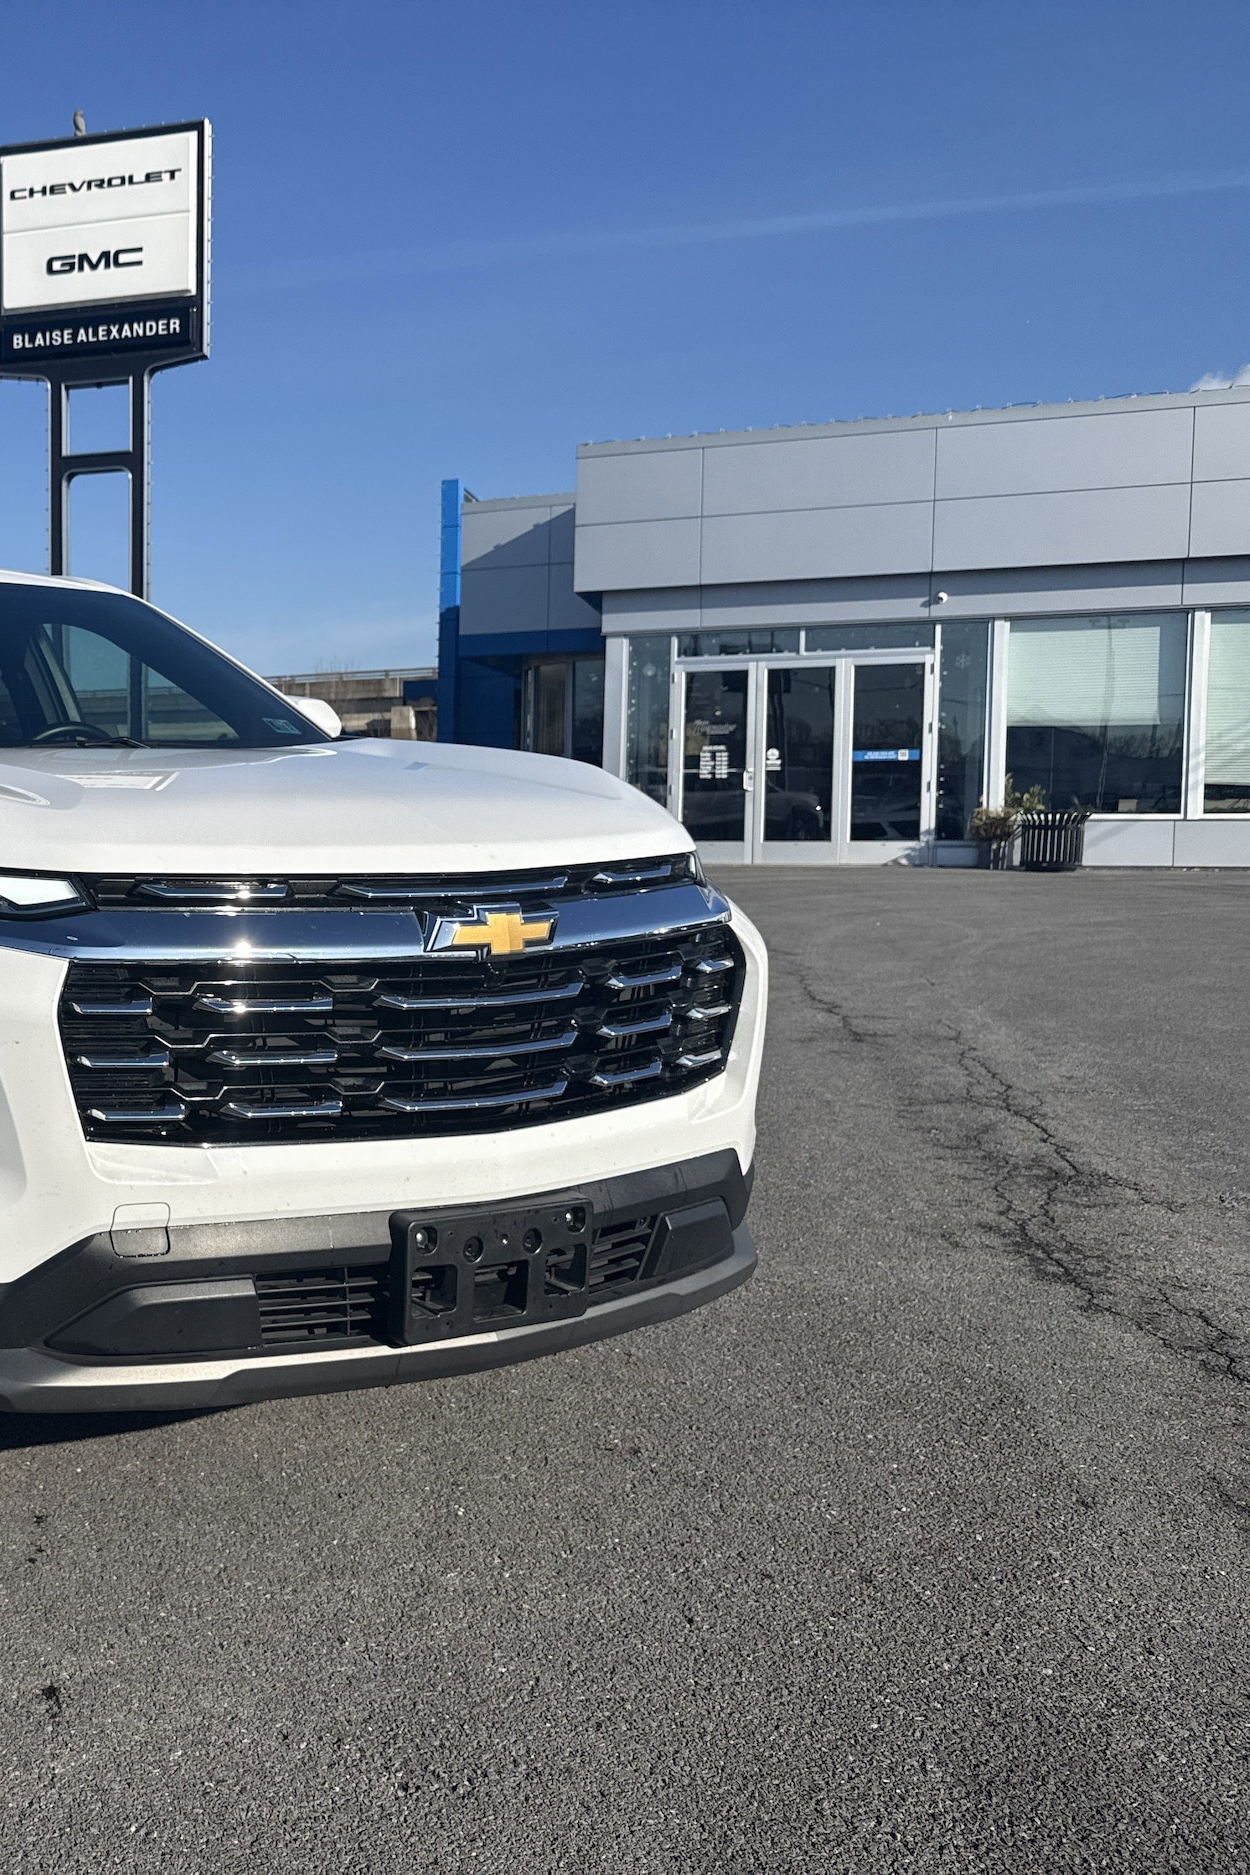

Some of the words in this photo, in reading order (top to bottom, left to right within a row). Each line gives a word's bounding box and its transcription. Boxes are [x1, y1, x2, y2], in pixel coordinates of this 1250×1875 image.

[9, 168, 182, 201] CHEVROLET
[46, 247, 143, 276] GMC
[12, 328, 74, 350] BLAISE
[77, 318, 182, 343] ALEXANDER
